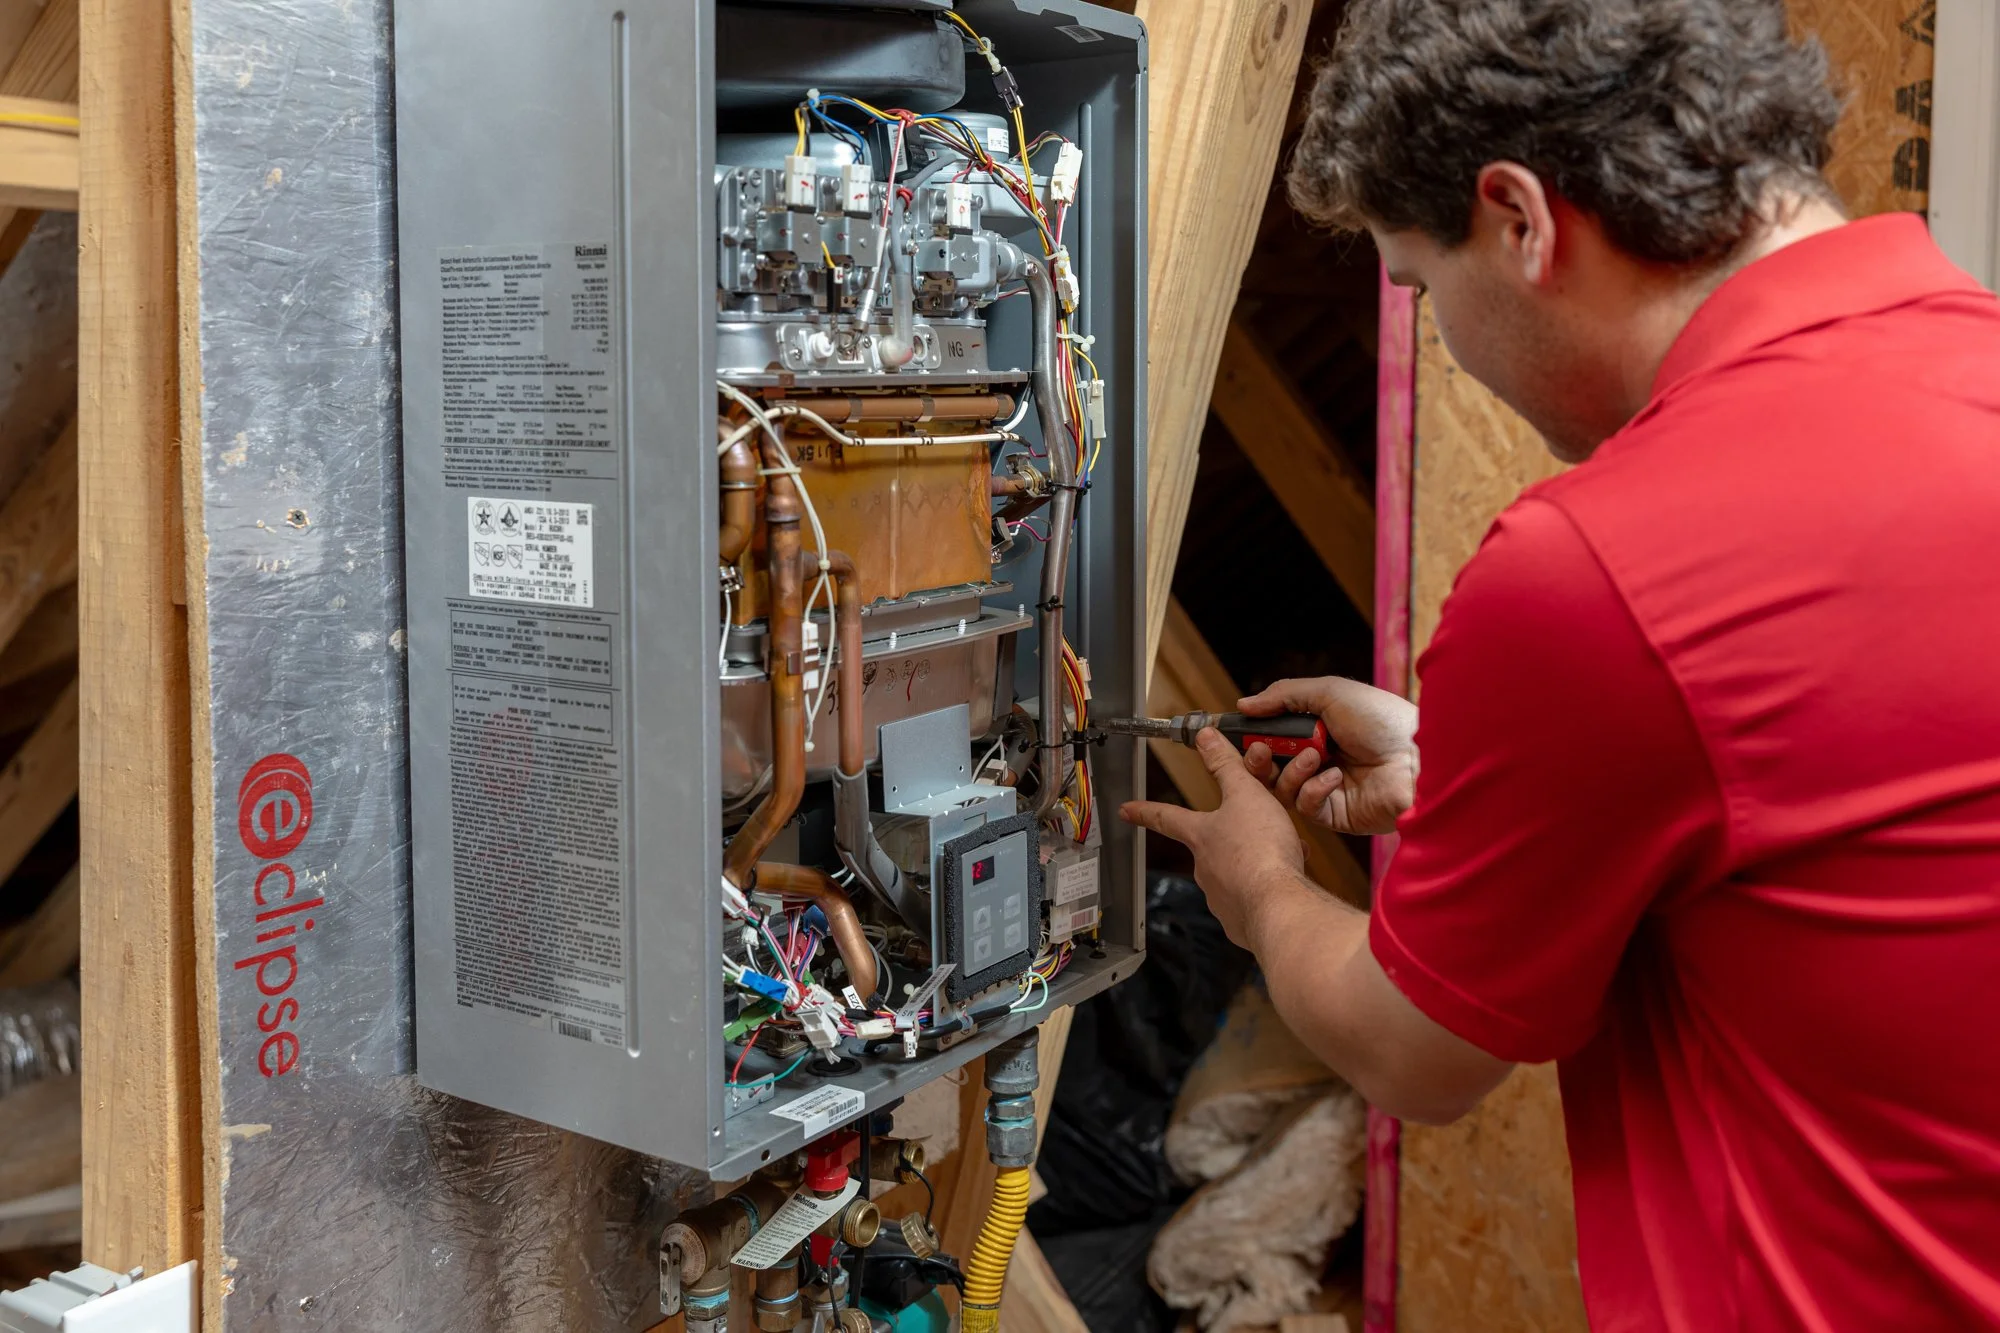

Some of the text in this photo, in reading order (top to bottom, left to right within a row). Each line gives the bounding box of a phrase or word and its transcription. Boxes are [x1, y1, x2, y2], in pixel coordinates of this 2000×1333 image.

[576, 244, 607, 257] Rinnai
[525, 544, 540, 552] SERIAL
[540, 562, 550, 570] MADE
[235, 753, 324, 1079] eclipse
